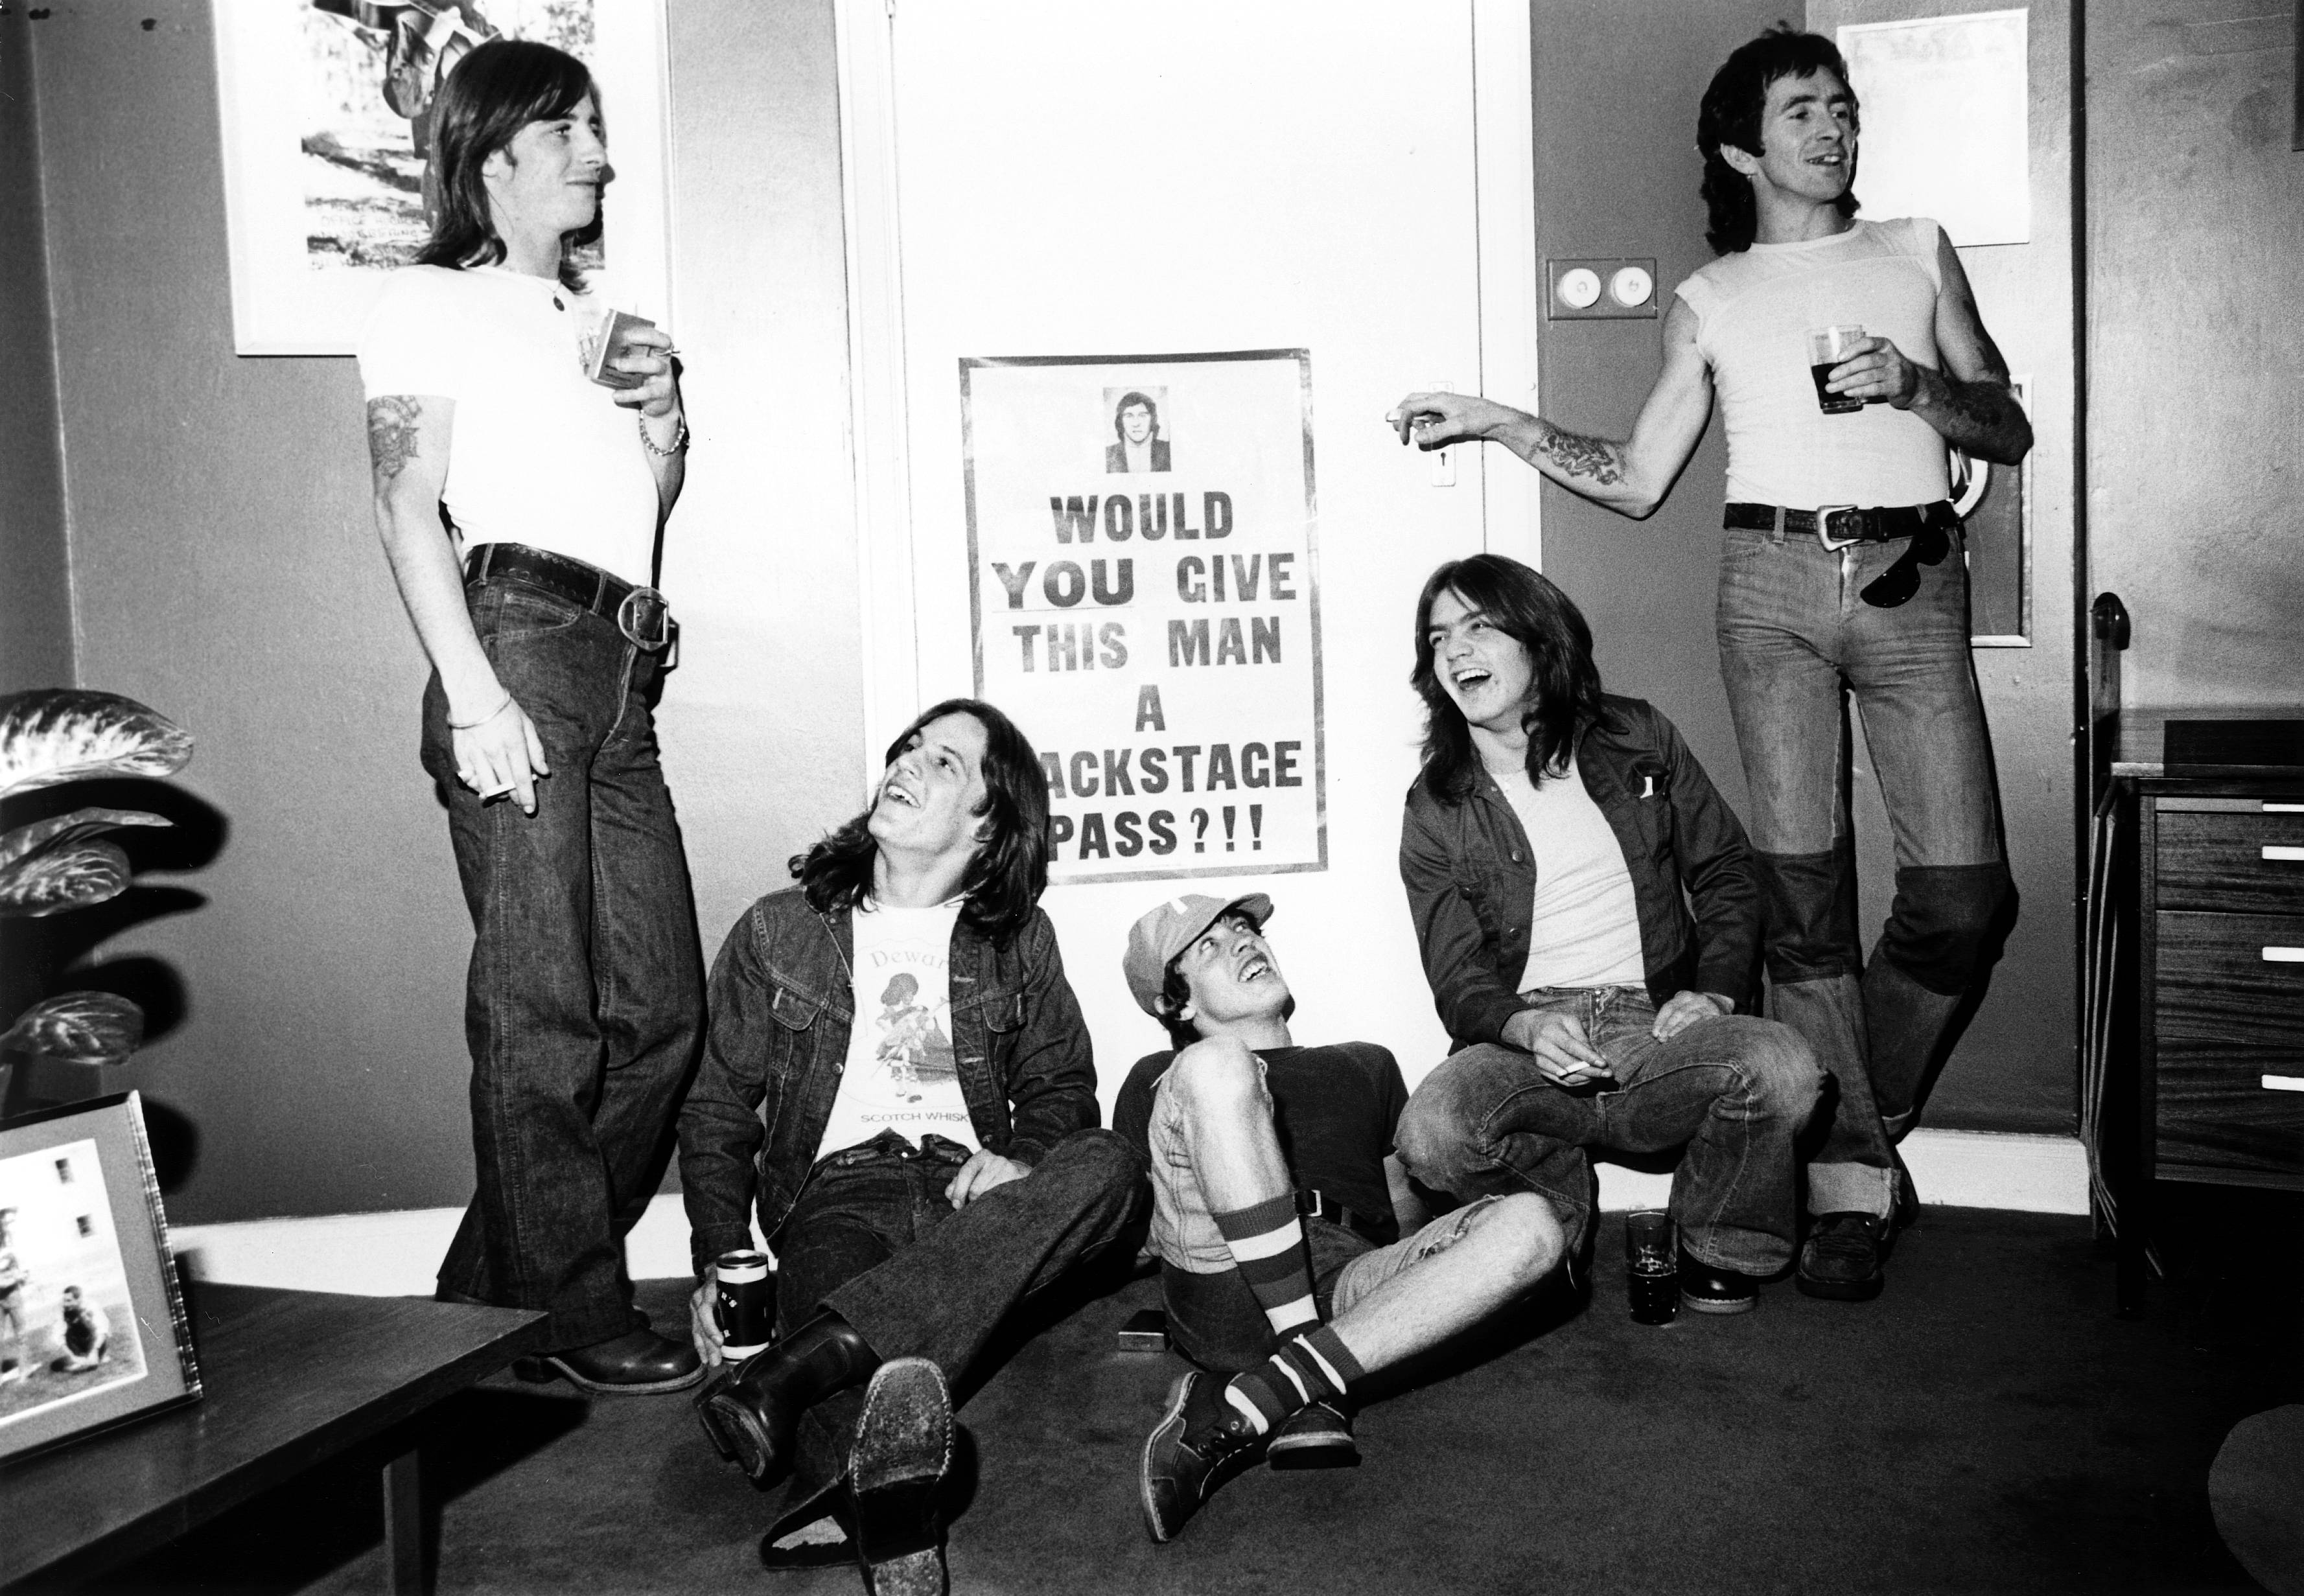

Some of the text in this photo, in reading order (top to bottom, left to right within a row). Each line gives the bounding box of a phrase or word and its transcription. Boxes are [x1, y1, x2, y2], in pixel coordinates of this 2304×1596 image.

[1049, 491, 1233, 544] WOULD
[991, 552, 1297, 610] YOU GIVE
[1012, 616, 1282, 673] THIS MAN
[1135, 684, 1167, 732] A
[1040, 740, 1303, 799] ACKSTAGE
[870, 949, 949, 969] Dewar
[861, 1112, 970, 1122] SCOTCH WHISK
